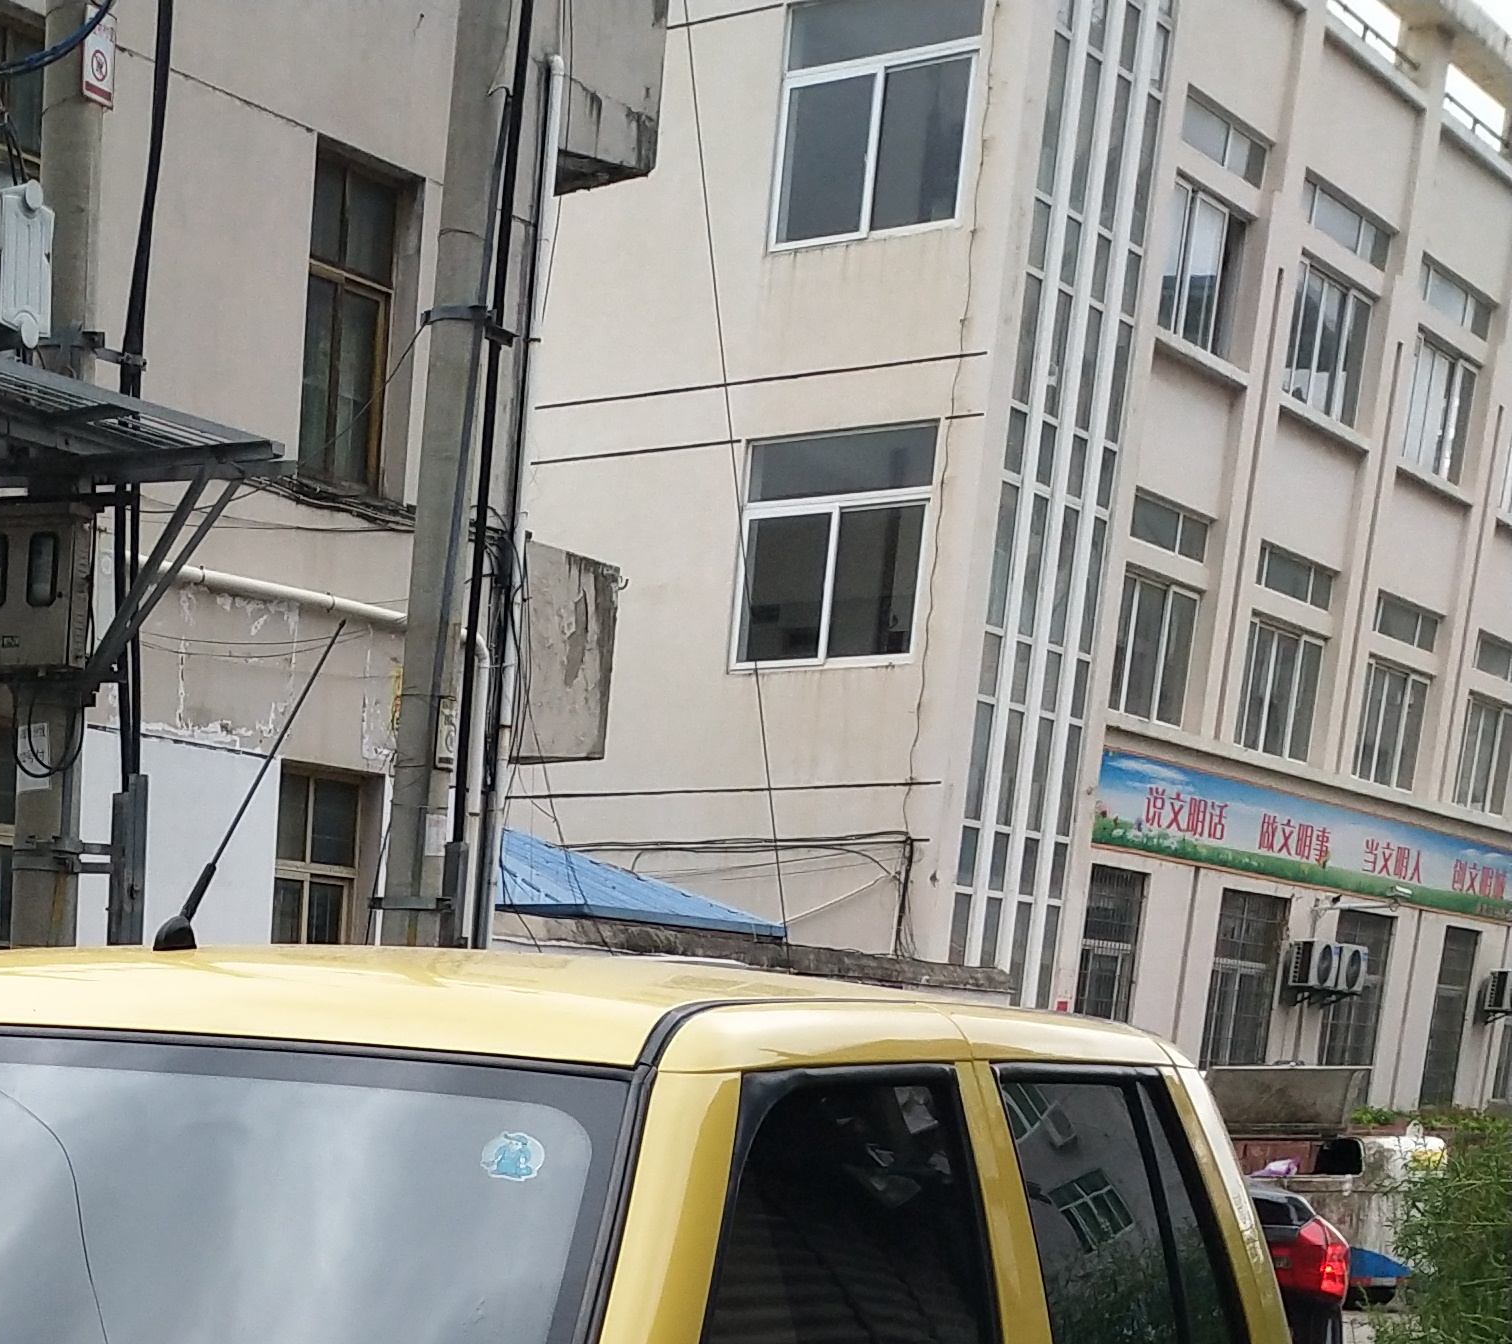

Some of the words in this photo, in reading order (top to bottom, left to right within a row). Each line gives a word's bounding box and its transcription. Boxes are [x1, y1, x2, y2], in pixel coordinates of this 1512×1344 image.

[1144, 786, 1229, 841] 说文明话
[1257, 812, 1331, 863] 做文明事
[1361, 838, 1422, 884] 当文明人
